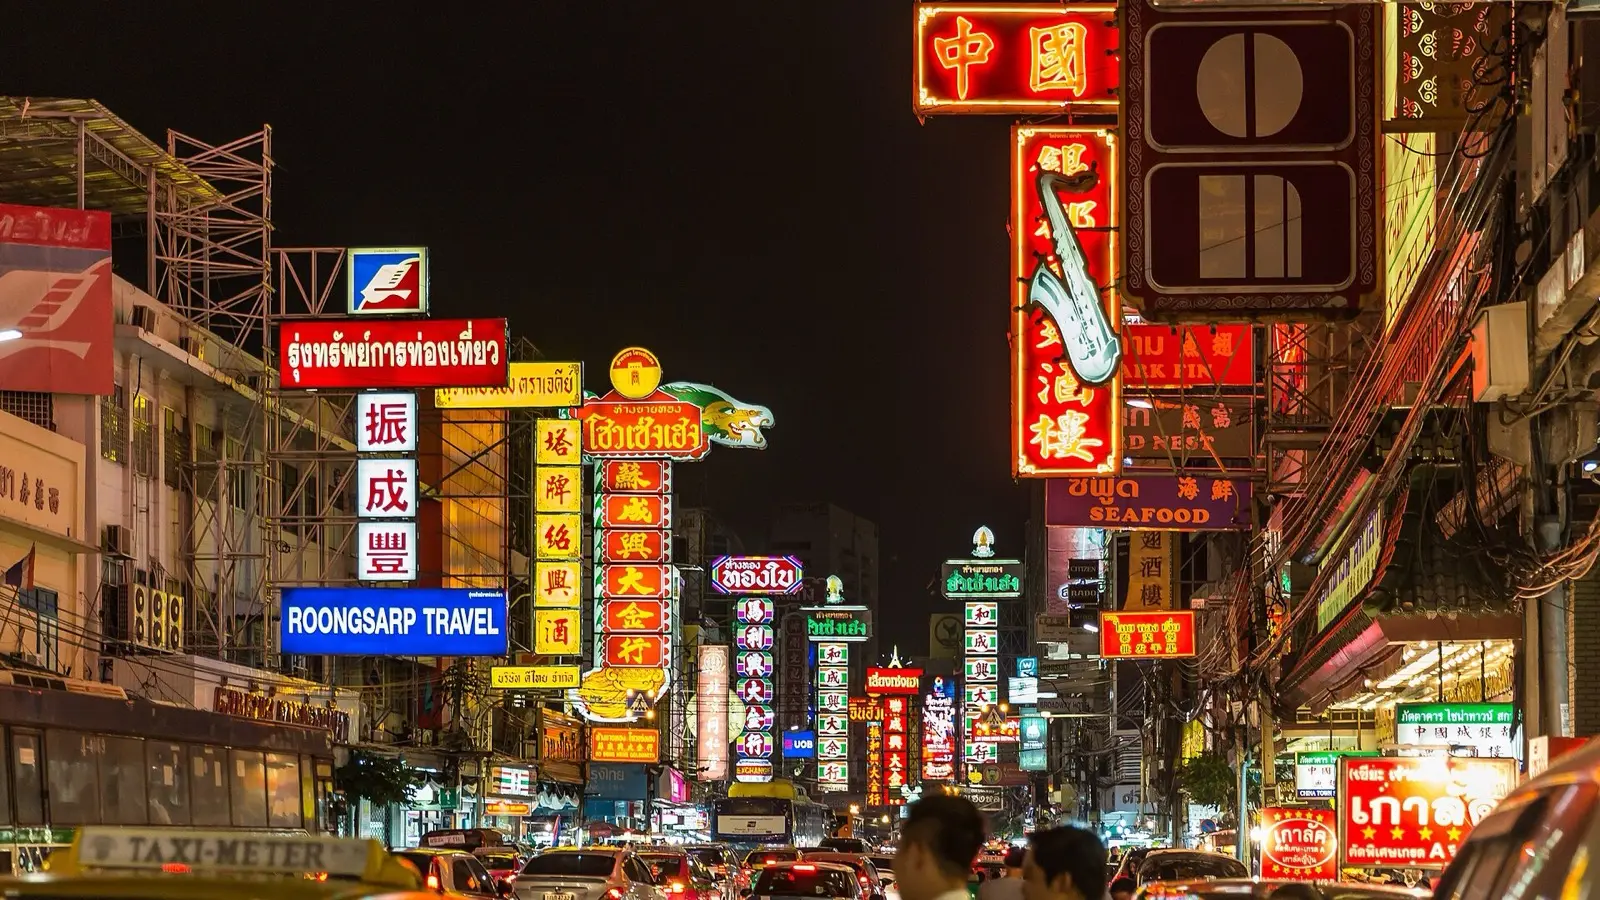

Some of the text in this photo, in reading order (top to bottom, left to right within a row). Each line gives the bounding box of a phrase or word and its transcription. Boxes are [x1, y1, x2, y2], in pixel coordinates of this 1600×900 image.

[934, 17, 1088, 100] 中國
[1029, 143, 1103, 462] 銀酒樓
[287, 321, 499, 382] รุ่งทรัพย์การท่องเที่ยว
[1174, 363, 1213, 378] FIN
[613, 404, 682, 415] ห้างขายทอง
[1153, 435, 1215, 451] NEST
[366, 403, 408, 574] 振成豐
[1178, 476, 1233, 503] 海鮮
[1090, 507, 1210, 523] SEAFOOD
[1070, 565, 1096, 573] CITIZEN
[288, 606, 499, 635] ROONGSARP TRAVEL
[498, 671, 520, 684] บริษัท
[552, 671, 573, 683] จำกัด
[974, 607, 989, 760] 和成興大行
[1040, 701, 1070, 709] BROADWAY
[1401, 710, 1443, 722] ภัตตาคาร
[1445, 708, 1493, 722] ไชน่าทาวน์
[794, 740, 813, 749] UOB
[888, 699, 903, 804] 聯成興大金
[736, 767, 771, 776] EXCHANGE
[129, 836, 326, 868] TAXI-METER
[1429, 841, 1445, 858] A
